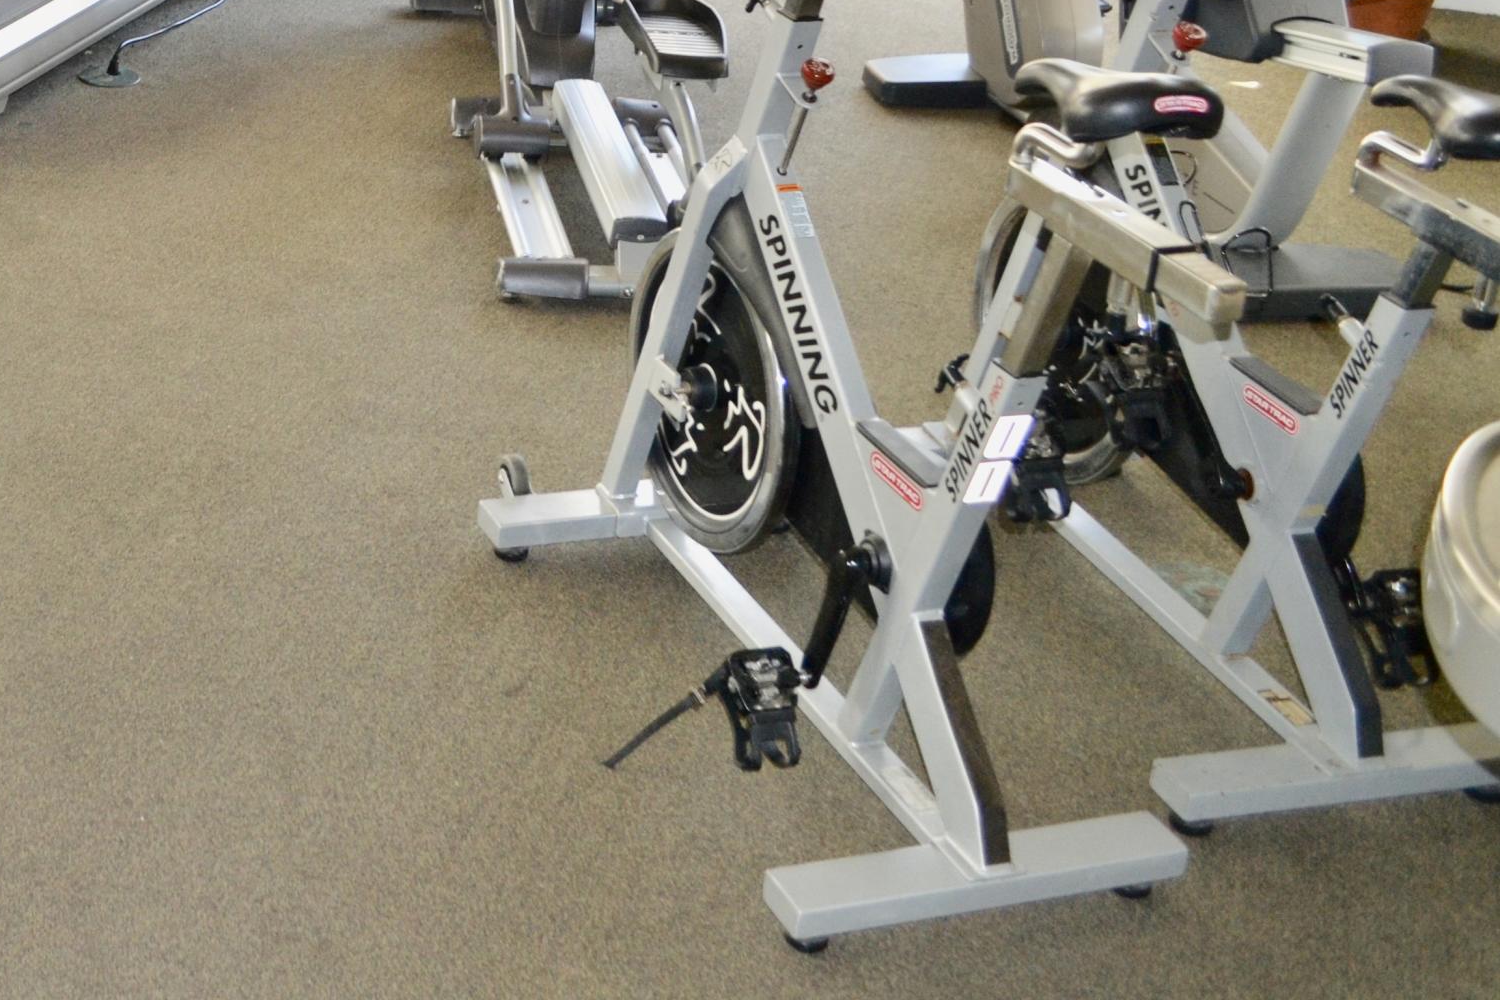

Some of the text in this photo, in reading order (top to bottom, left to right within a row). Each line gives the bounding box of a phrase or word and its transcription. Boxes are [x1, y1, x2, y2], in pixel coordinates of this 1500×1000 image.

[758, 214, 838, 415] SPINNING
[1329, 329, 1380, 420] SPINNER
[944, 398, 992, 504] SPINNER
